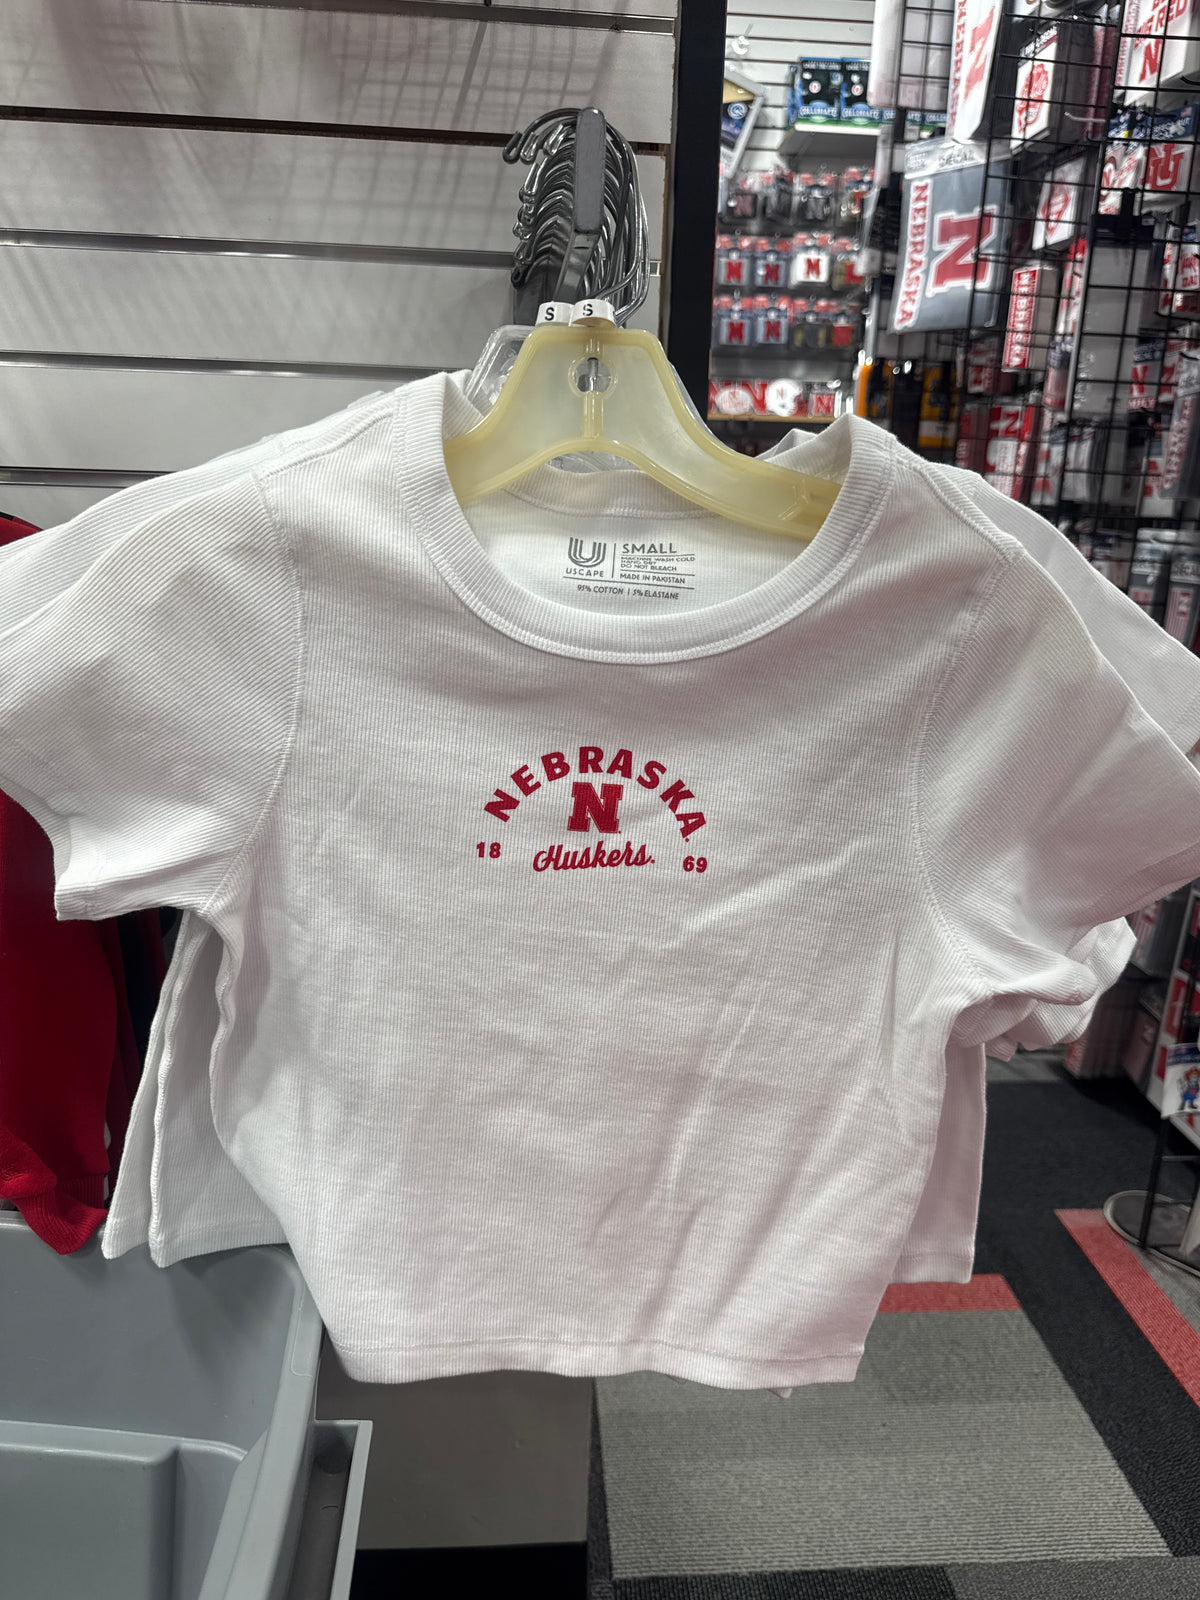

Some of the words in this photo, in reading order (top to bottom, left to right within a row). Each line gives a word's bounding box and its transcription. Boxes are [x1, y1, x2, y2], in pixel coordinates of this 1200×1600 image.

[897, 182, 929, 325] NEBRASKA
[932, 211, 994, 288] N
[544, 307, 555, 321] S
[582, 304, 594, 317] S
[622, 543, 677, 554] SMALL
[565, 567, 605, 577] USCAPE
[652, 575, 686, 584] PAKISTAN
[577, 584, 591, 592] 95%
[593, 585, 624, 595] COTTON
[644, 590, 679, 600] ELASTANE
[484, 746, 706, 839] NEBRASKA
[567, 781, 624, 834] N
[476, 842, 501, 859] 18
[682, 855, 708, 874] 69
